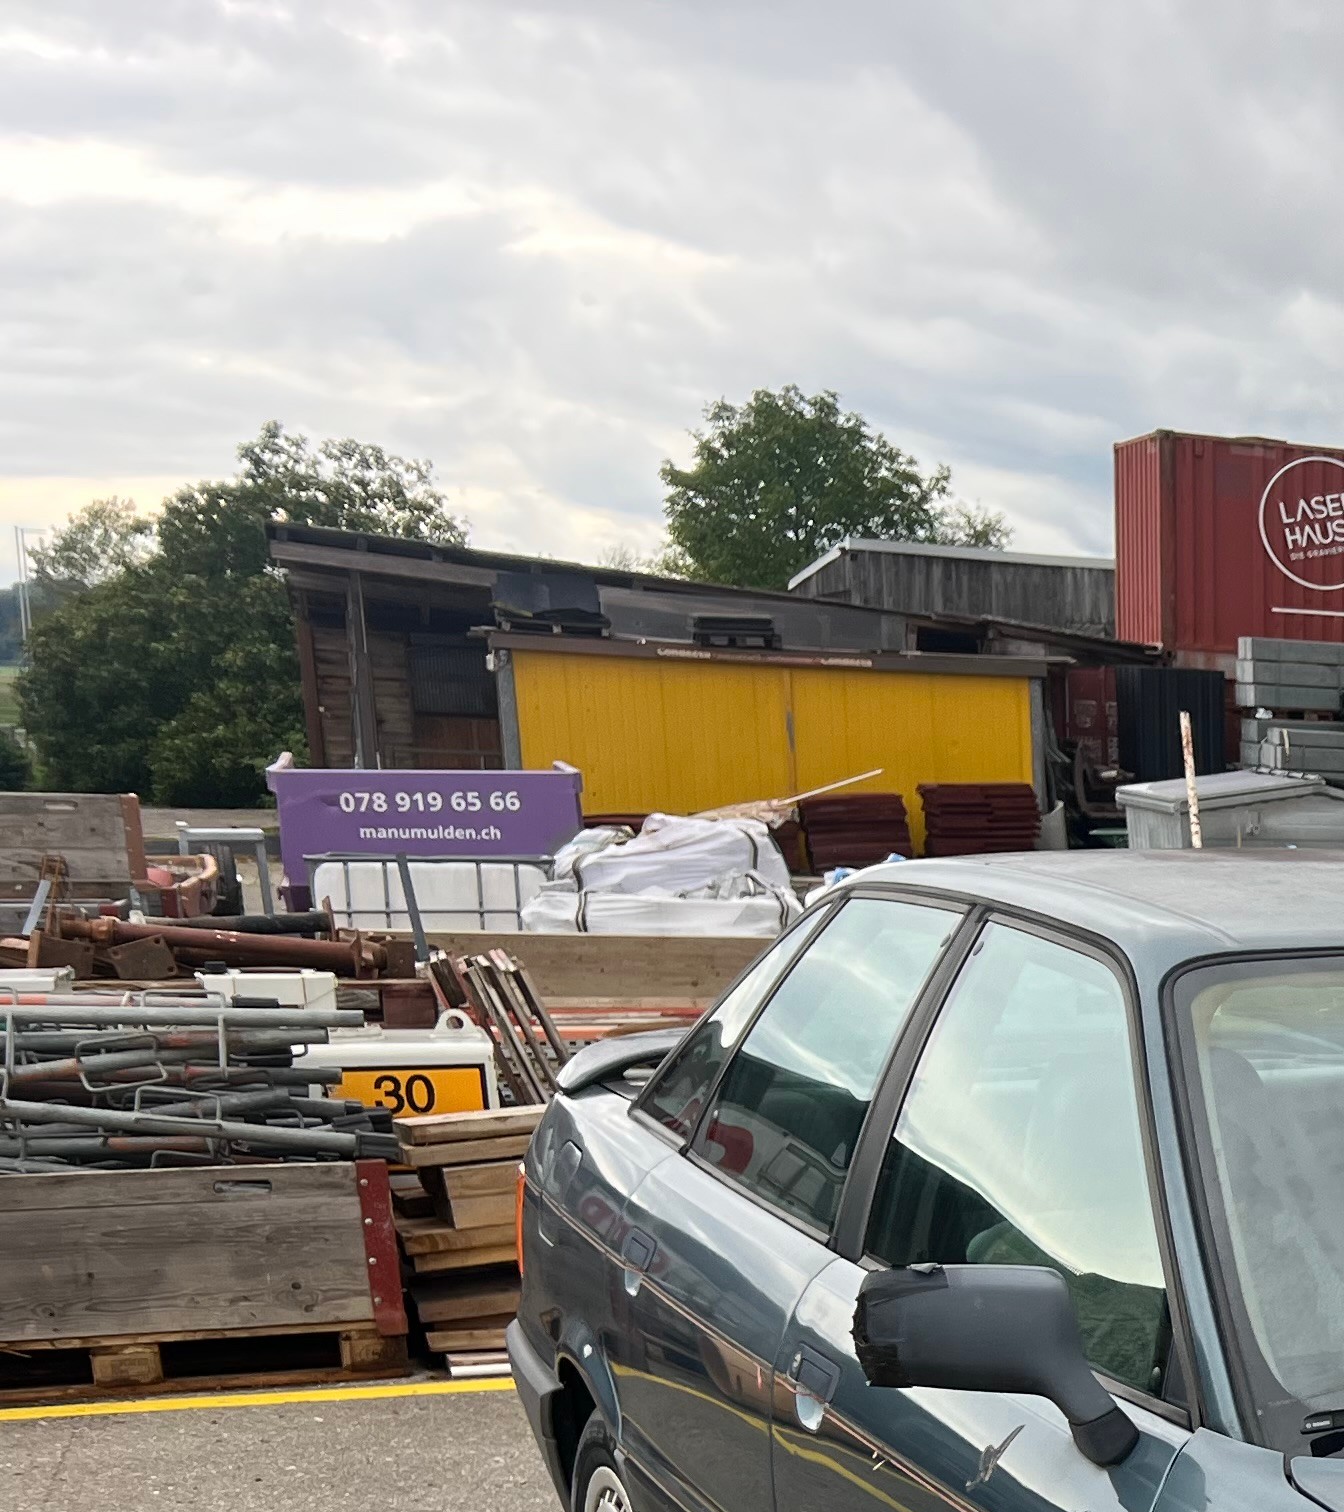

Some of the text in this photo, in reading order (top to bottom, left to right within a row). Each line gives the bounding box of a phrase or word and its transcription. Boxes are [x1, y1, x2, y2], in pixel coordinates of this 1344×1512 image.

[339, 791, 521, 812] 078 919 65 66
[359, 825, 501, 840] manumulden.ch
[374, 1074, 435, 1114] 30
